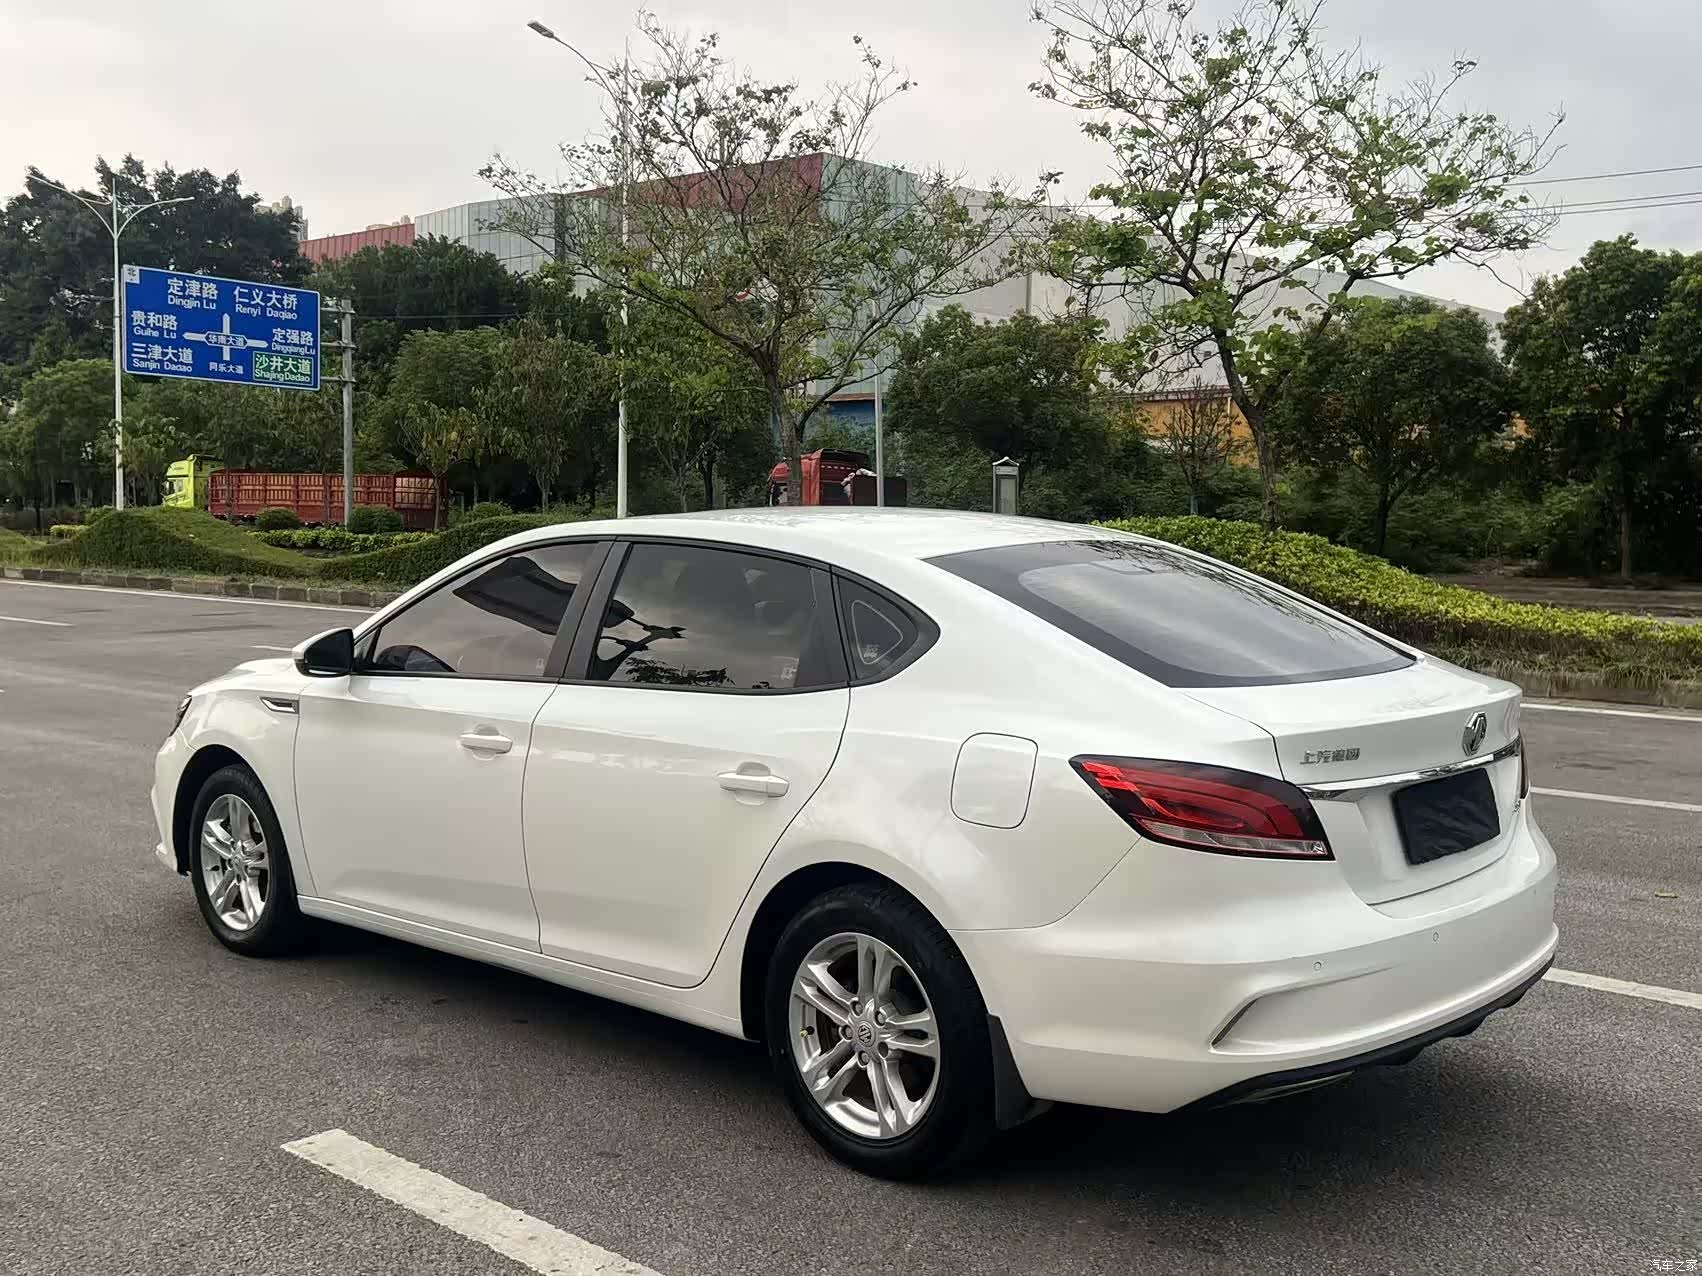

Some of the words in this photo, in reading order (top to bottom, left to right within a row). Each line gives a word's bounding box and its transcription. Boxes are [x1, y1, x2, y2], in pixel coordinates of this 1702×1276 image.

[167, 277, 219, 300] 定津路
[233, 286, 298, 310] 仁义大桥
[167, 294, 201, 309] Dingjin
[203, 299, 216, 310] Lu
[131, 310, 178, 331] 贵和路
[235, 303, 262, 317] Renyi
[266, 307, 298, 321] Daqiao
[133, 326, 160, 337] Guihe
[163, 329, 177, 339] Lu
[272, 328, 314, 346] 定强路
[131, 342, 194, 364] 三津大道
[132, 358, 160, 371] Sanjin
[163, 361, 193, 373] Dadao
[255, 354, 311, 375] 沙井大道
